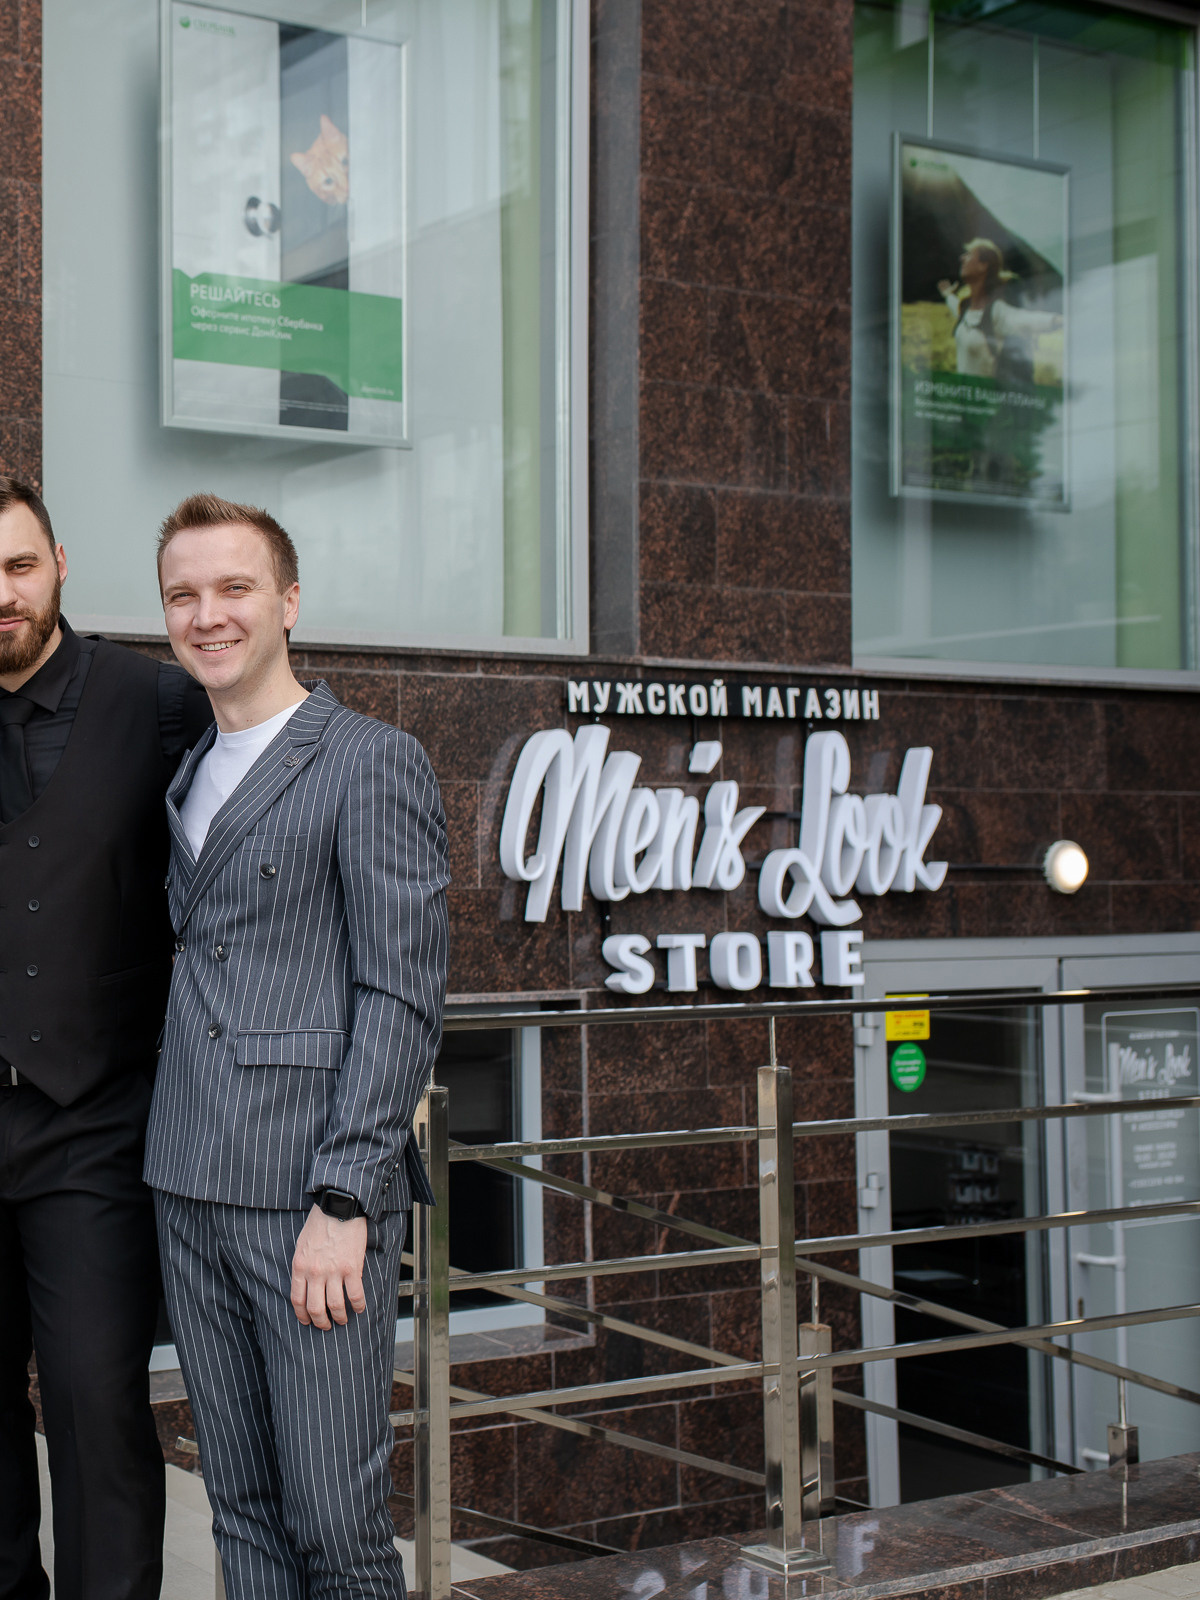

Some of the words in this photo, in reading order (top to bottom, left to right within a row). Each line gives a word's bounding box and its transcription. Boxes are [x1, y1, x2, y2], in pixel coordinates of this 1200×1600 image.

[190, 283, 281, 308] РЕШАЙТЕСЬ
[567, 679, 729, 717] МУЖСКОЙ
[742, 686, 881, 720] МАГАЗИН
[500, 723, 767, 923] Men's
[758, 730, 949, 927] Look
[601, 930, 865, 994] STORE
